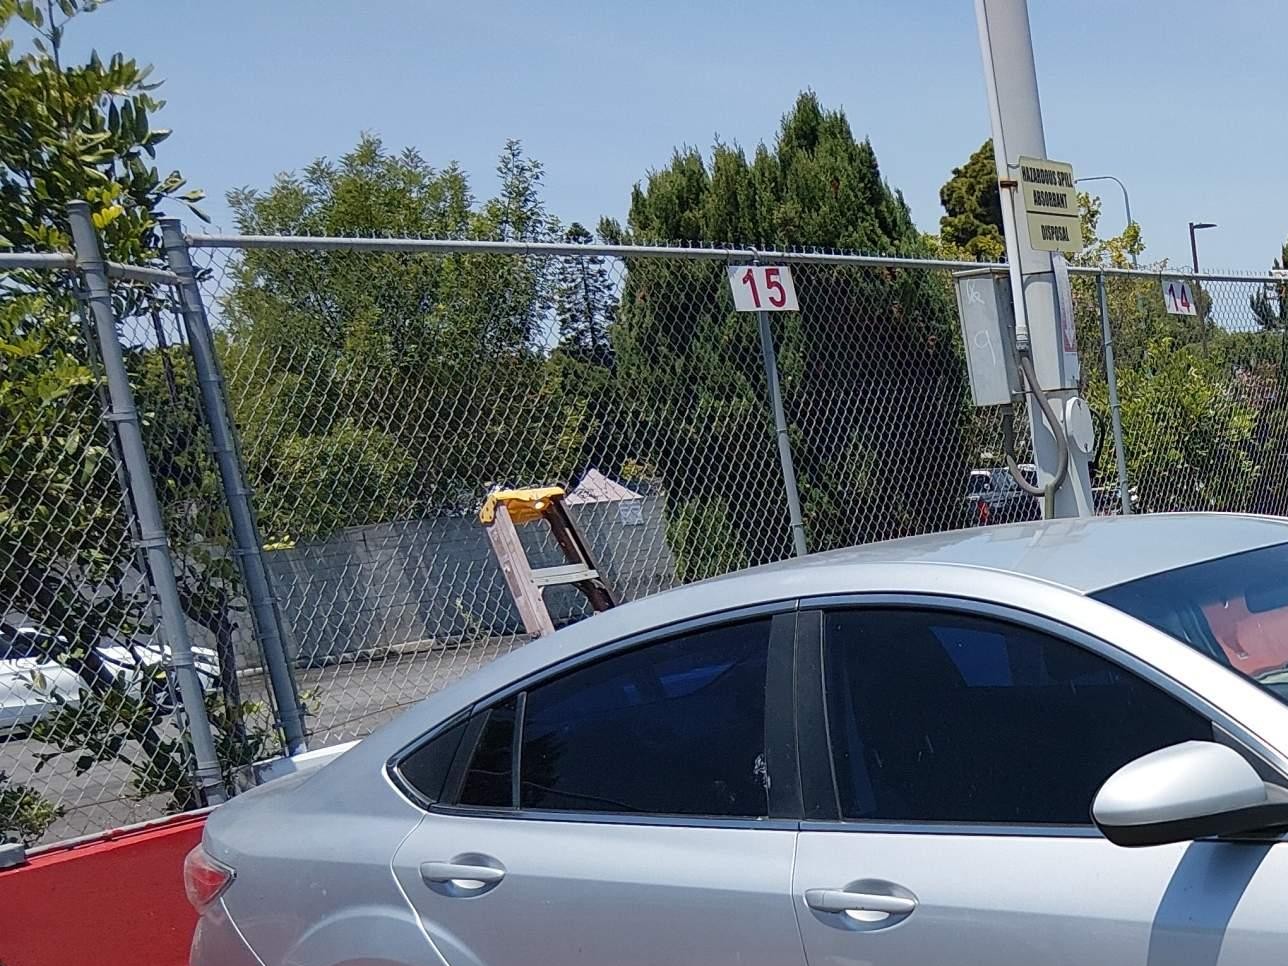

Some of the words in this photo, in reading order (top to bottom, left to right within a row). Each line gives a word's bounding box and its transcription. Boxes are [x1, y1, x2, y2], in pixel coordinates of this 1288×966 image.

[1021, 165, 1057, 186] HAZARDOUS
[1057, 170, 1074, 188] SPILL
[1040, 224, 1070, 242] DISPOSAL
[742, 267, 787, 309] 15
[1168, 283, 1191, 313] 14
